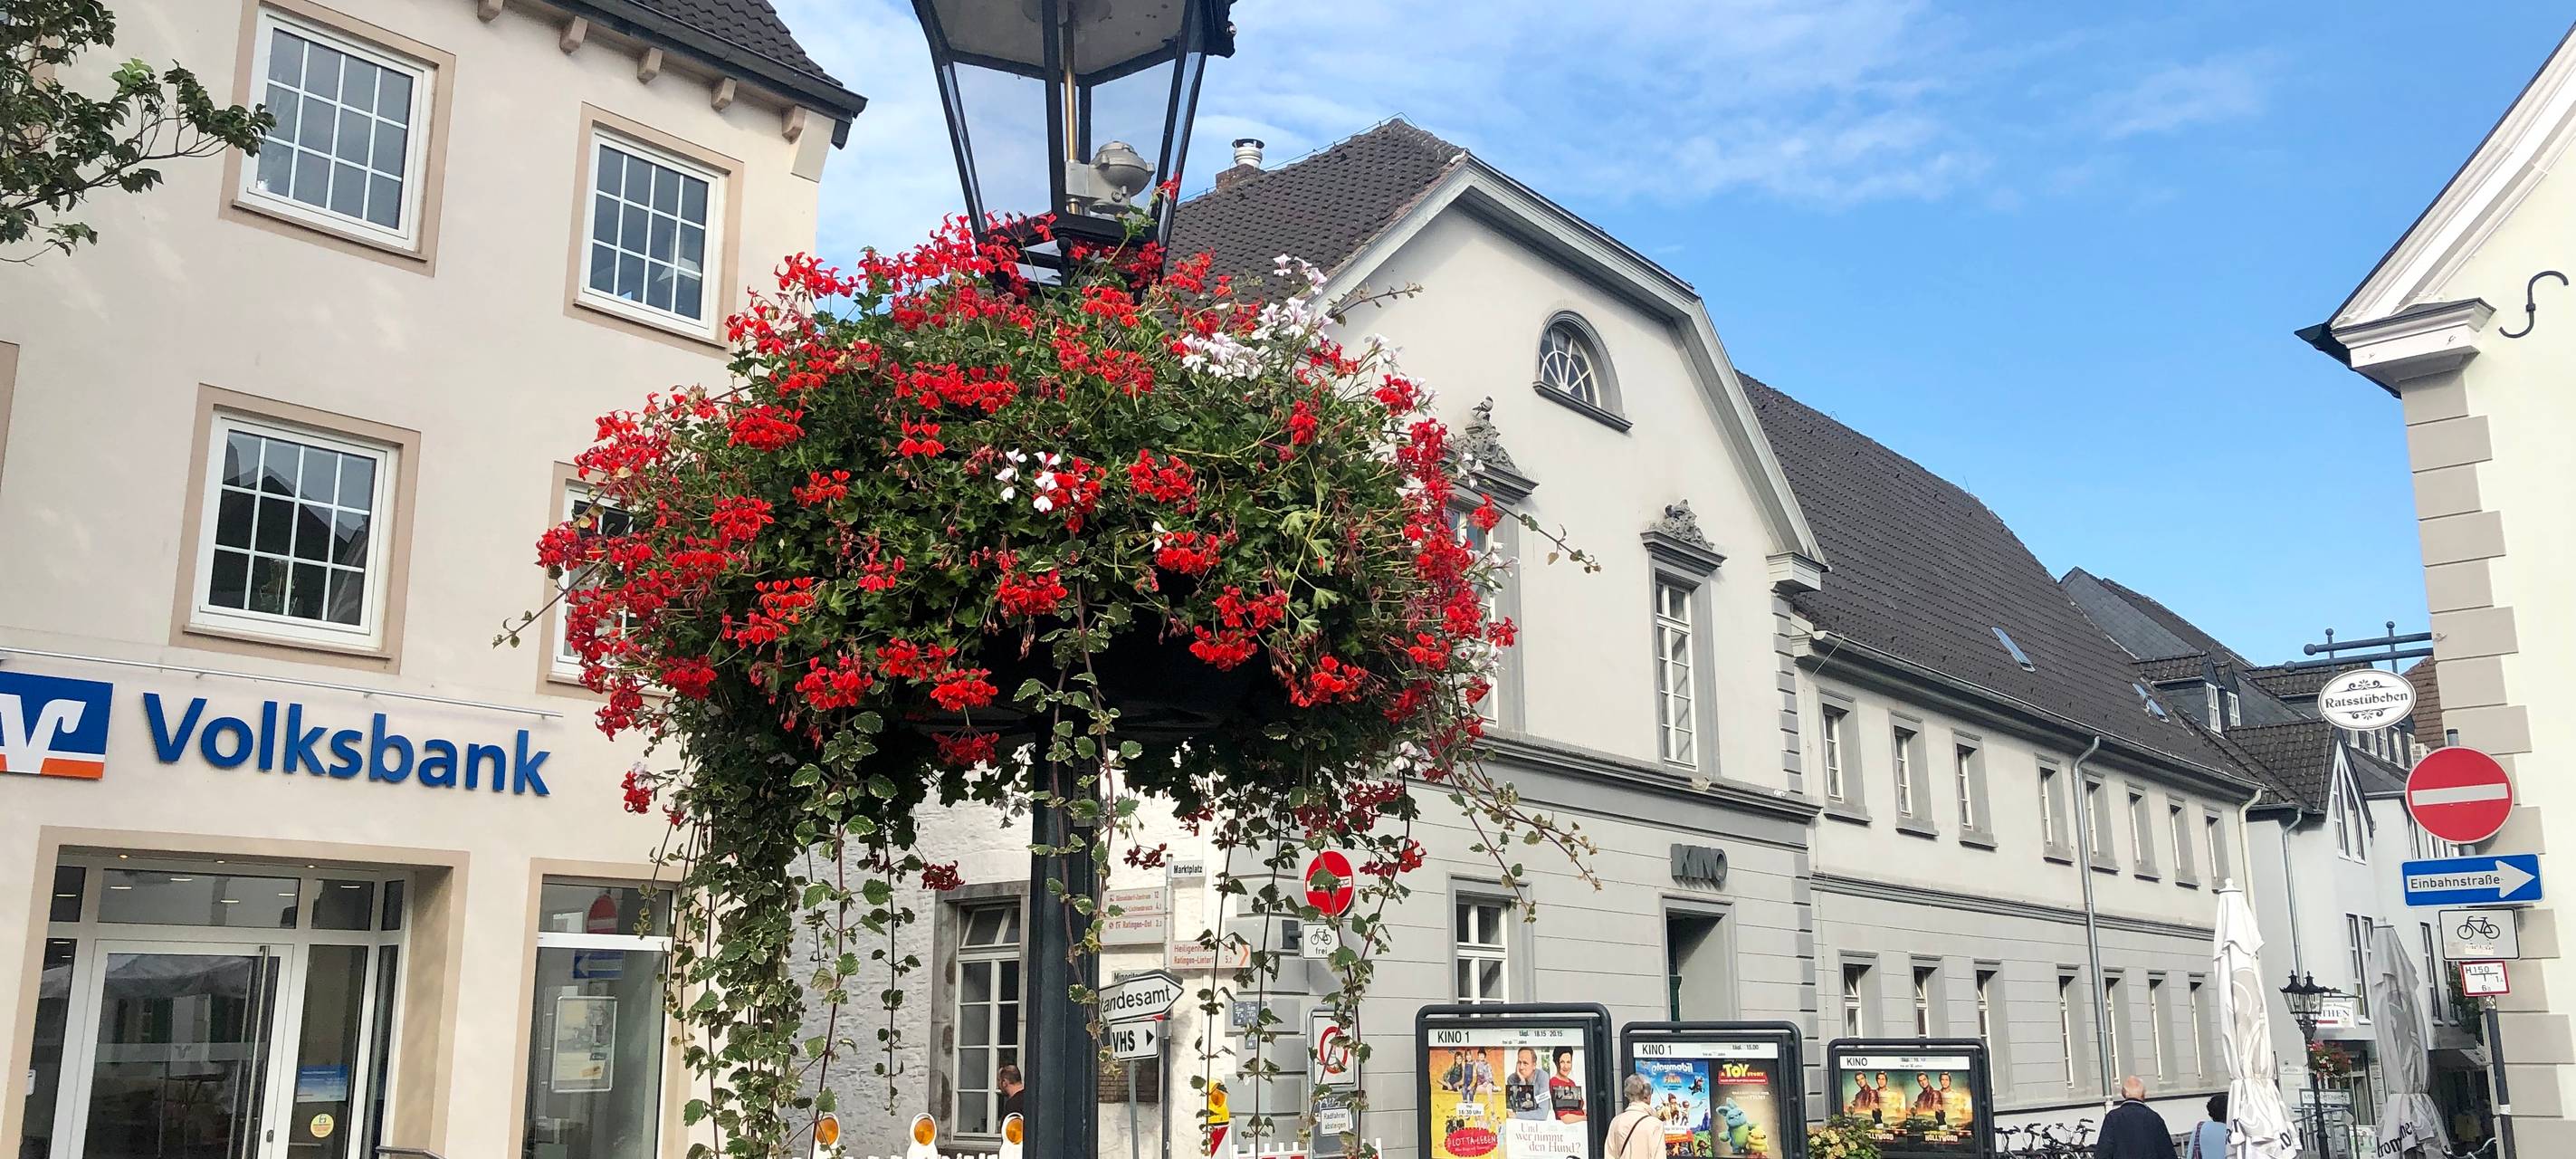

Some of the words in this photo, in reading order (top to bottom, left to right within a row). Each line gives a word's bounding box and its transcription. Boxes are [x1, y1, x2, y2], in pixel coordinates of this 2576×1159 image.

[2325, 692, 2408, 708] Ratsstübchen
[142, 692, 551, 796] Volksbank
[1670, 843, 1727, 883] KINO
[1173, 865, 1203, 876] Marktplatz
[2410, 874, 2500, 889] Einbahnstraße
[1100, 984, 1171, 1013] tandesamt
[1437, 1030, 1462, 1044] KINO
[1465, 1030, 1470, 1044] 1
[1549, 1030, 1563, 1038] 20.15
[1111, 1030, 1136, 1053] VHS
[1642, 1044, 1665, 1055] KINO
[1668, 1045, 1673, 1055] 1
[1651, 1062, 1693, 1075] playmobil
[1846, 1058, 1868, 1067] KINO
[1722, 1063, 1750, 1078] TOY
[1323, 1112, 1346, 1120] Radfahrer
[1324, 1122, 1347, 1131] absteigen
[1521, 1122, 1539, 1134] Und
[1515, 1132, 1531, 1141] wer
[1533, 1132, 1564, 1143] nimmt
[1924, 1134, 1959, 1143] HOLLYWOOD
[1529, 1140, 1546, 1152] den
[1549, 1141, 1581, 1154] Hund?
